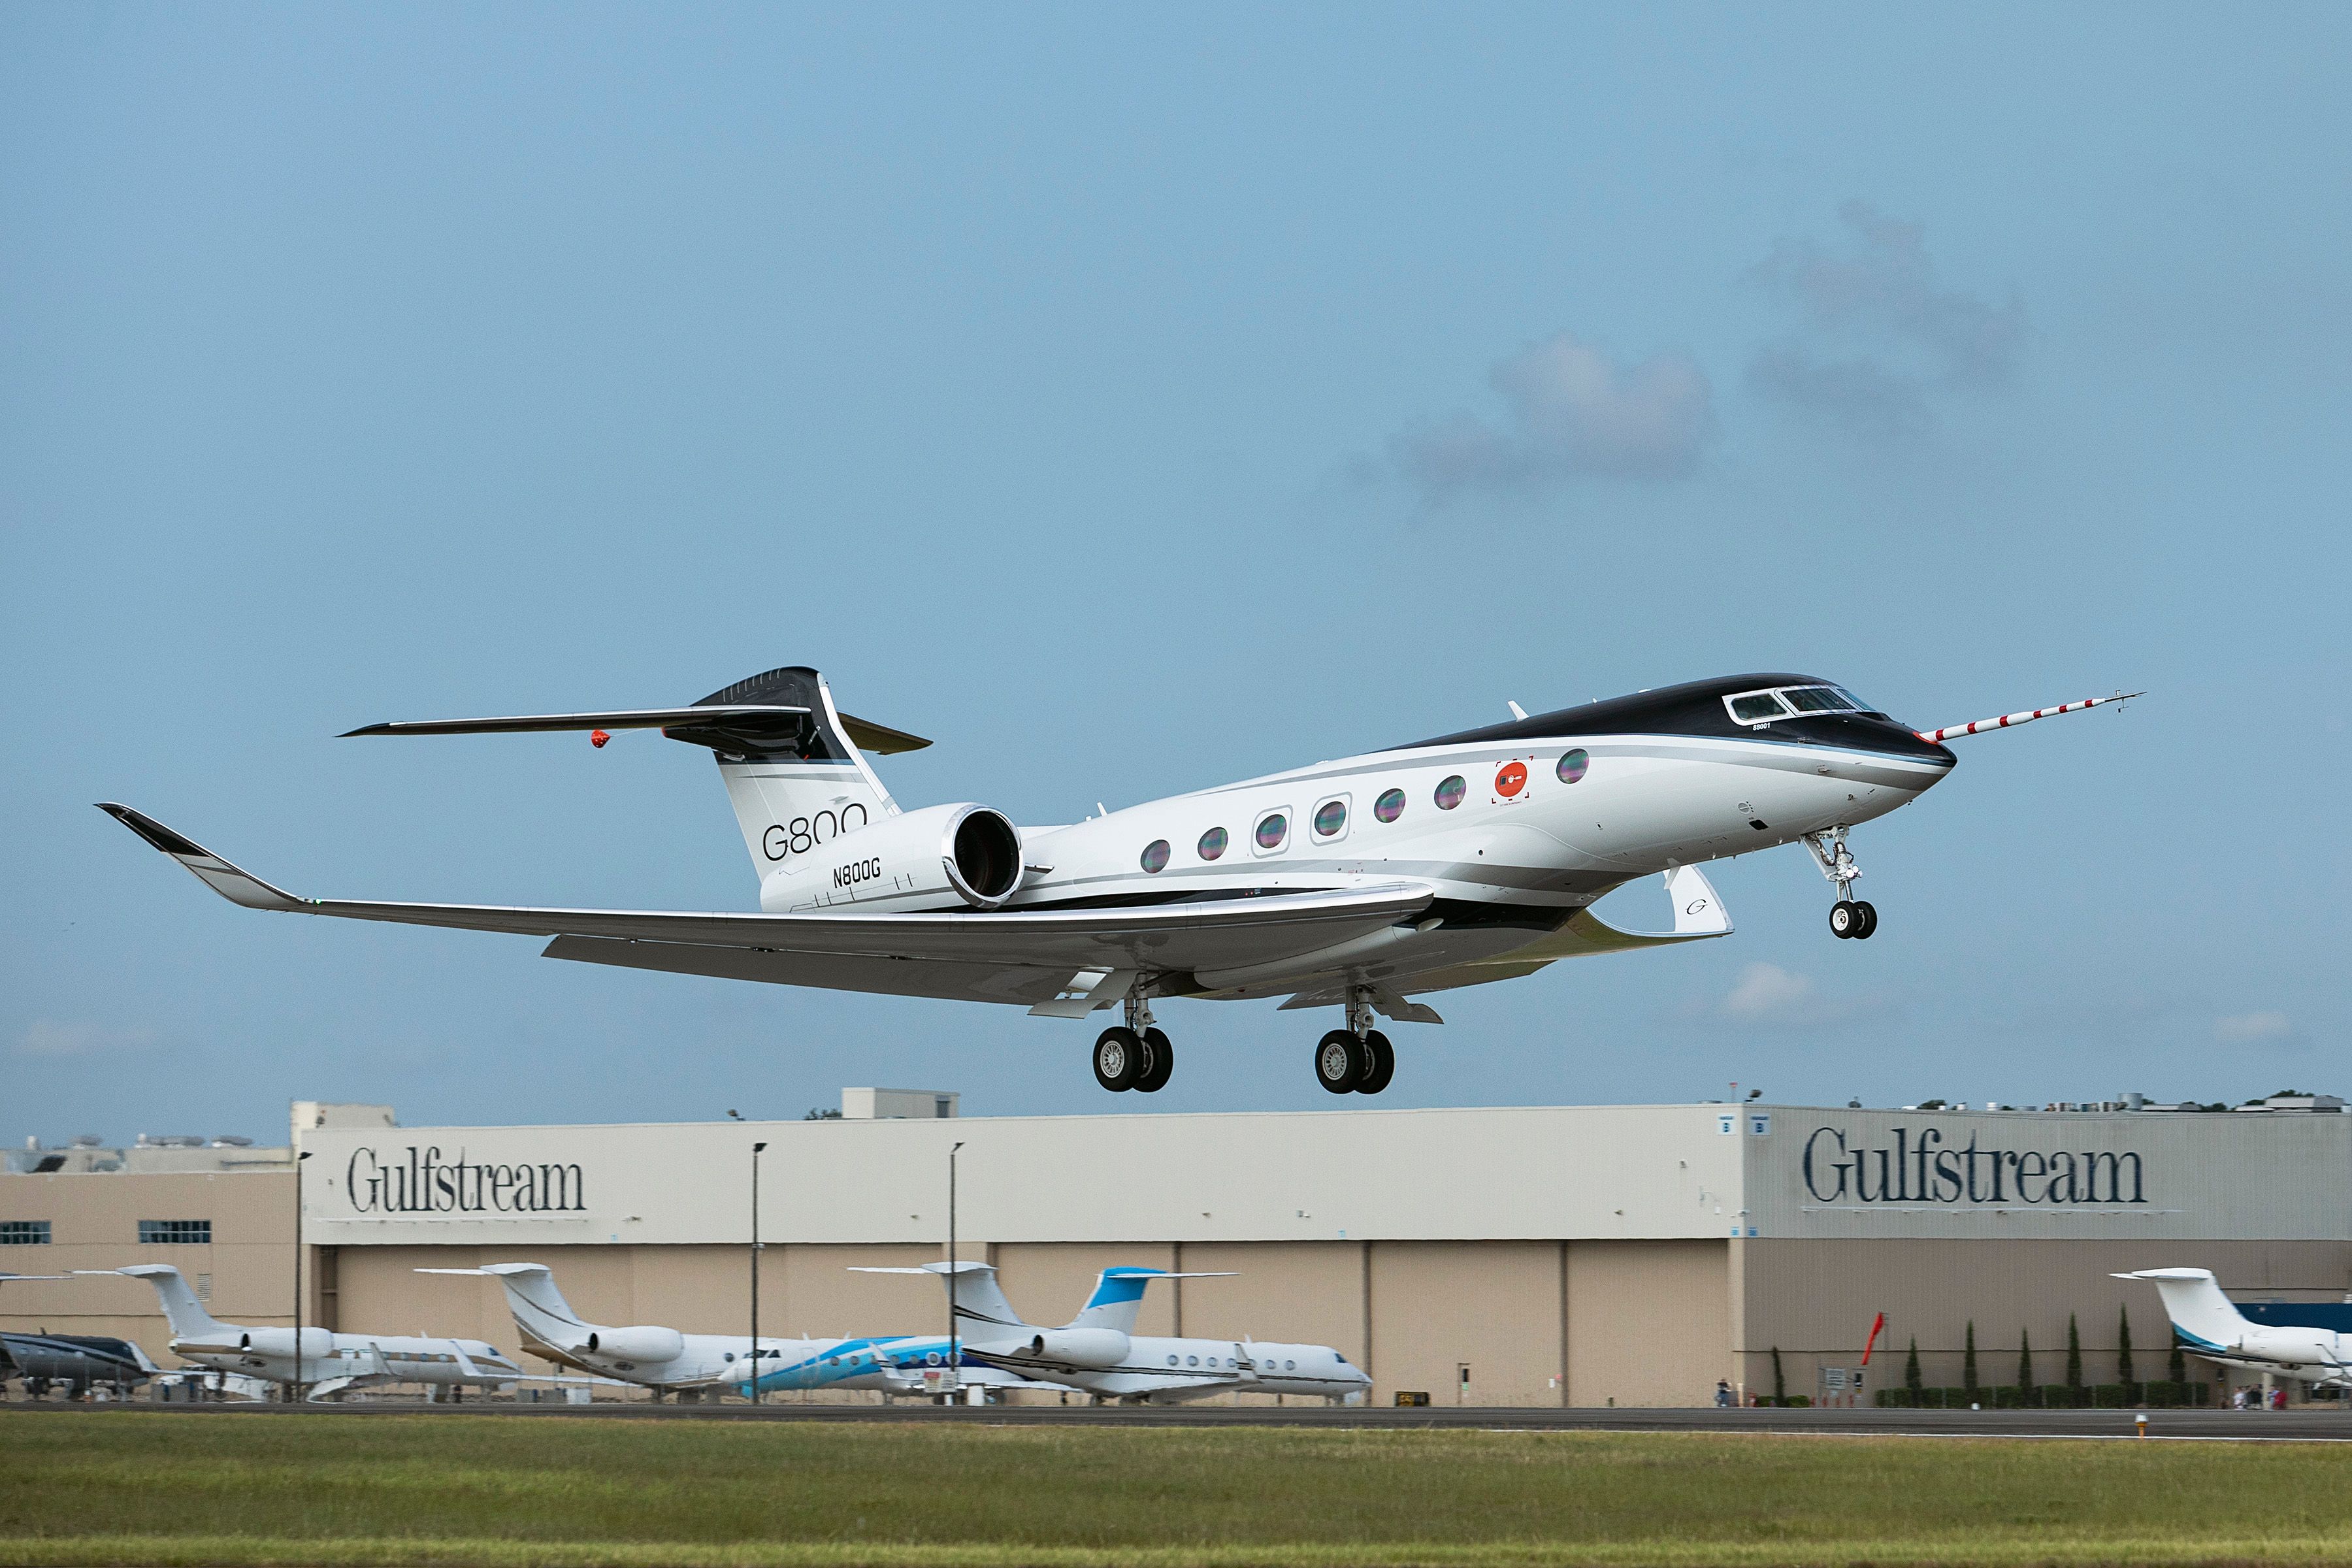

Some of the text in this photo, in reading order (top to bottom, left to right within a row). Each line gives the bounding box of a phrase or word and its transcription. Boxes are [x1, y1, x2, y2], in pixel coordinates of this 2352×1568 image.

[1752, 723, 1771, 731] 88001
[763, 803, 868, 861] G800
[834, 857, 881, 889] N800G
[347, 1146, 587, 1212] Gulfstream
[1802, 1127, 2148, 1203] Gulfstream
